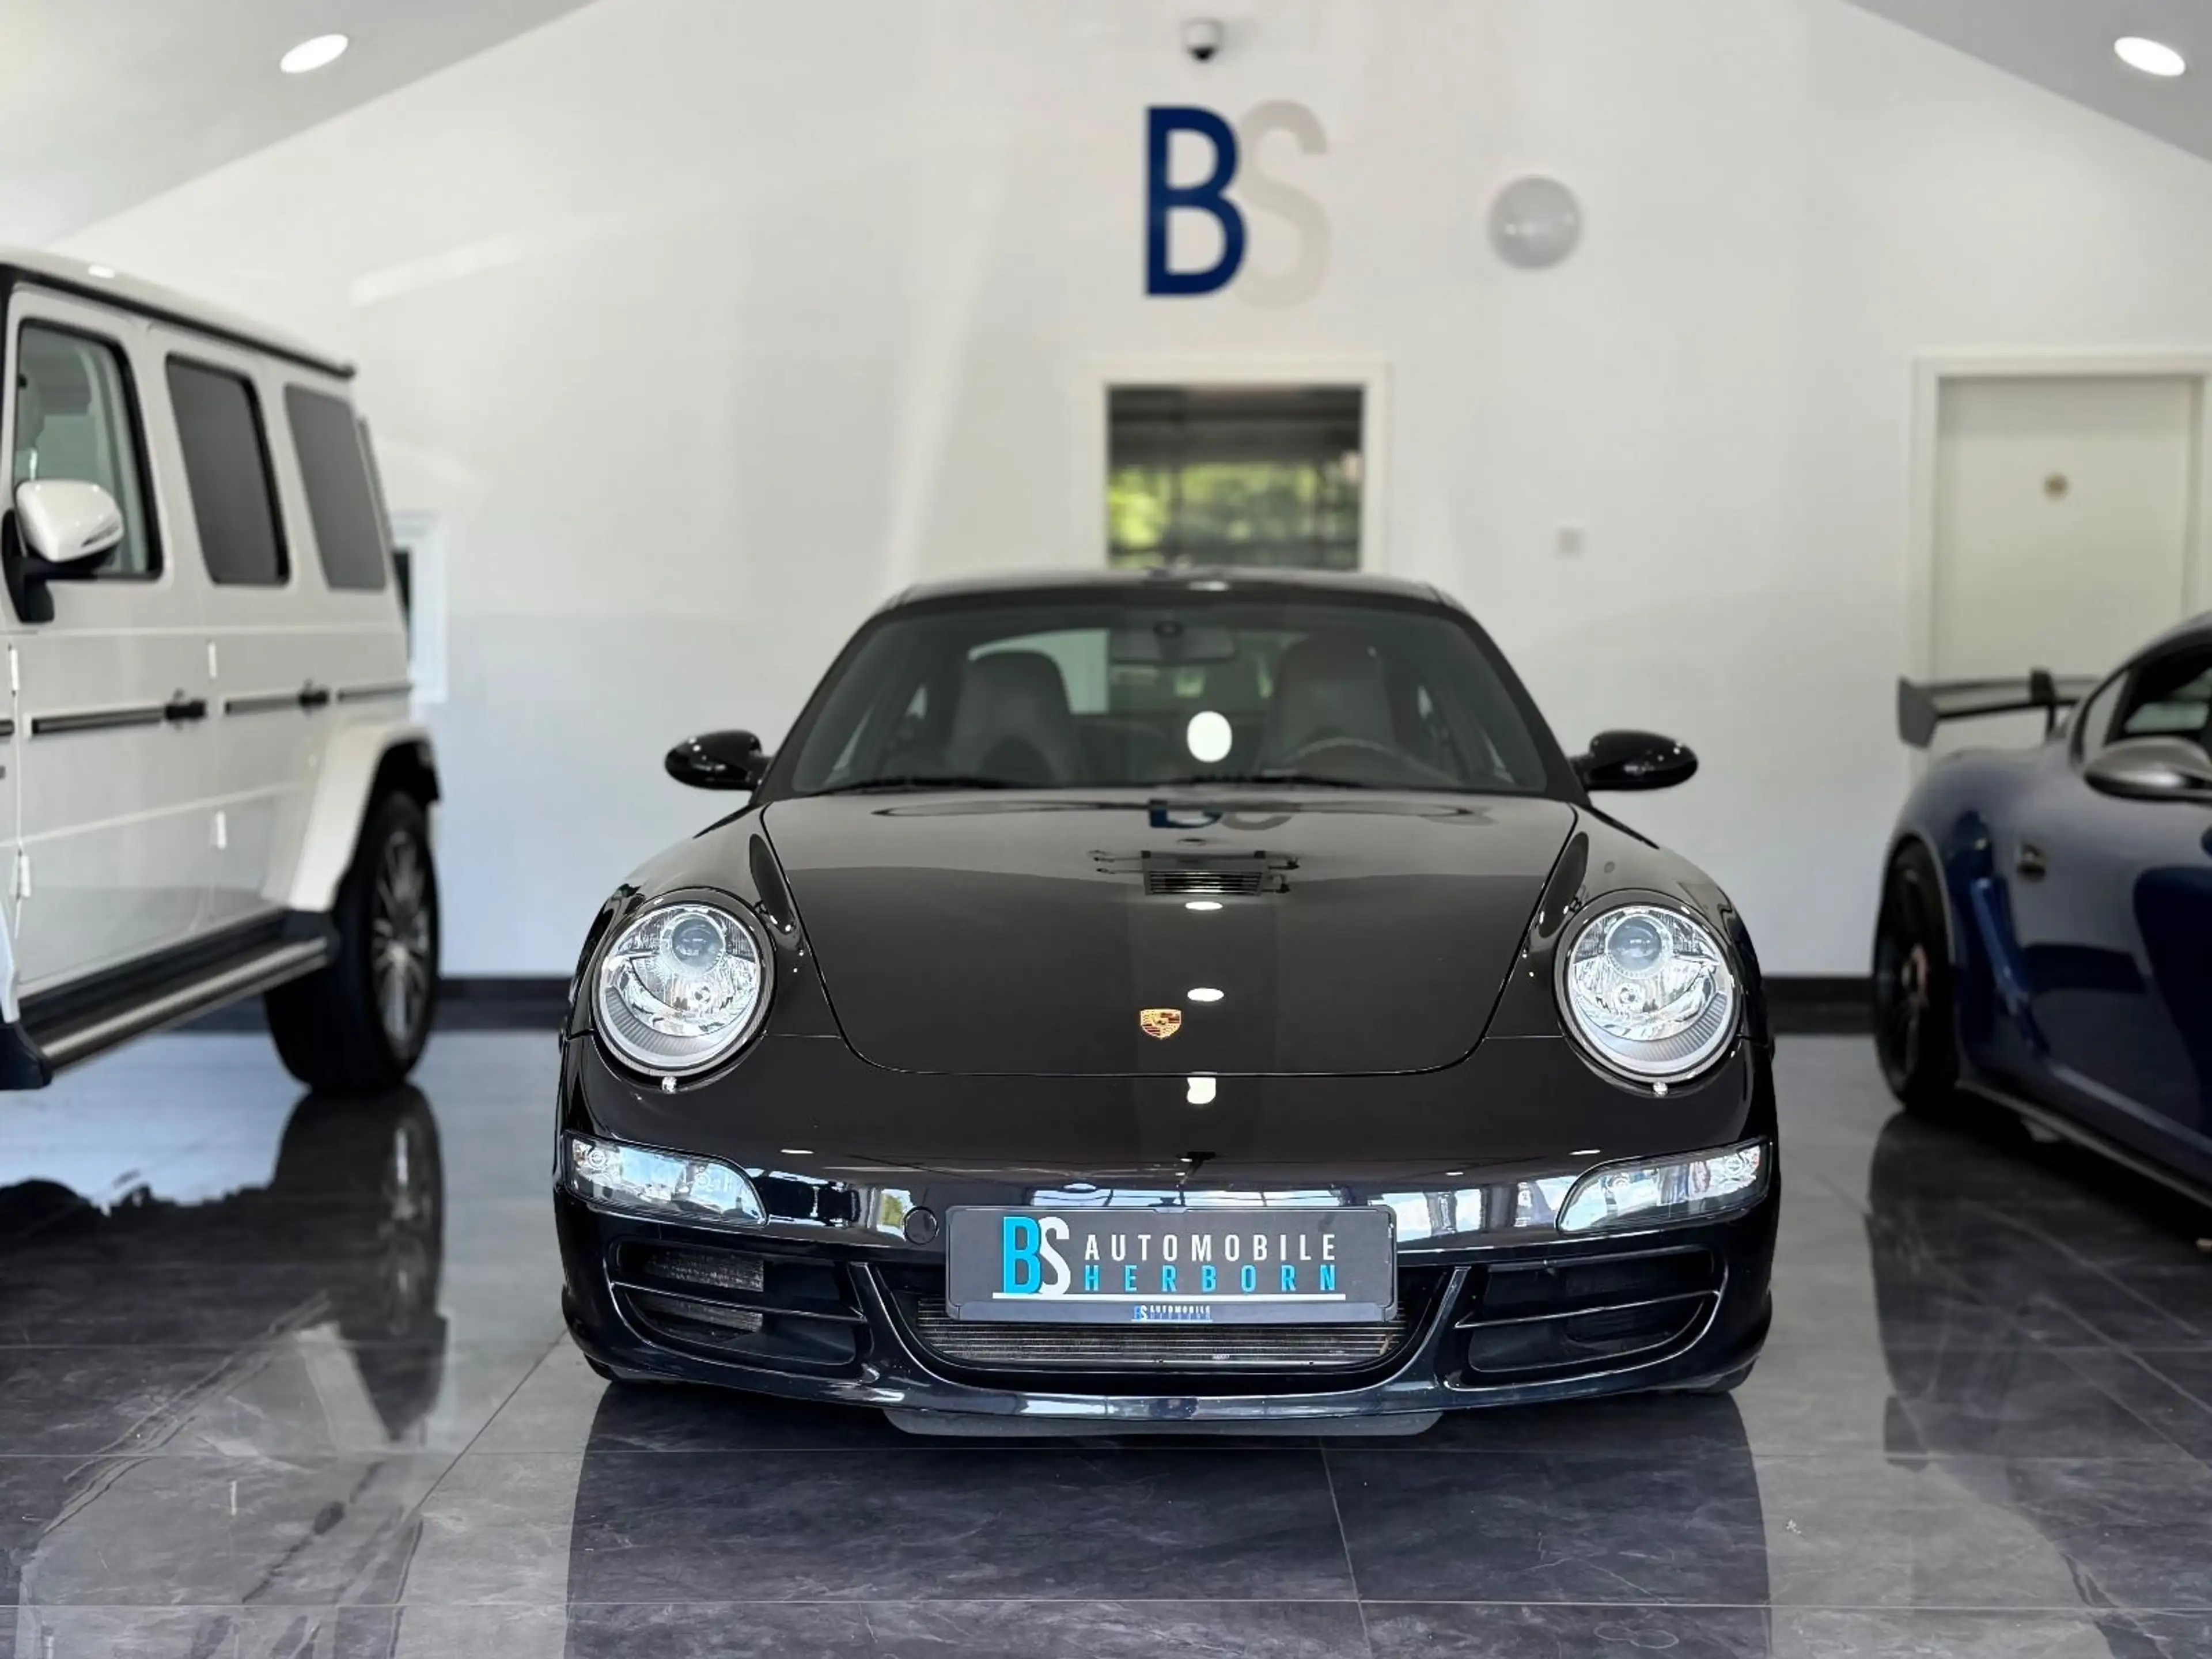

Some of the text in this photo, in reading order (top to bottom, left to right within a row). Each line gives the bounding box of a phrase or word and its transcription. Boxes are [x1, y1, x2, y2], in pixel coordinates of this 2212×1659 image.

[1146, 99, 1331, 309] BS
[1003, 1215, 1336, 1294] BS AUTOMOBILE
[1084, 1265, 1336, 1292] HERBORN
